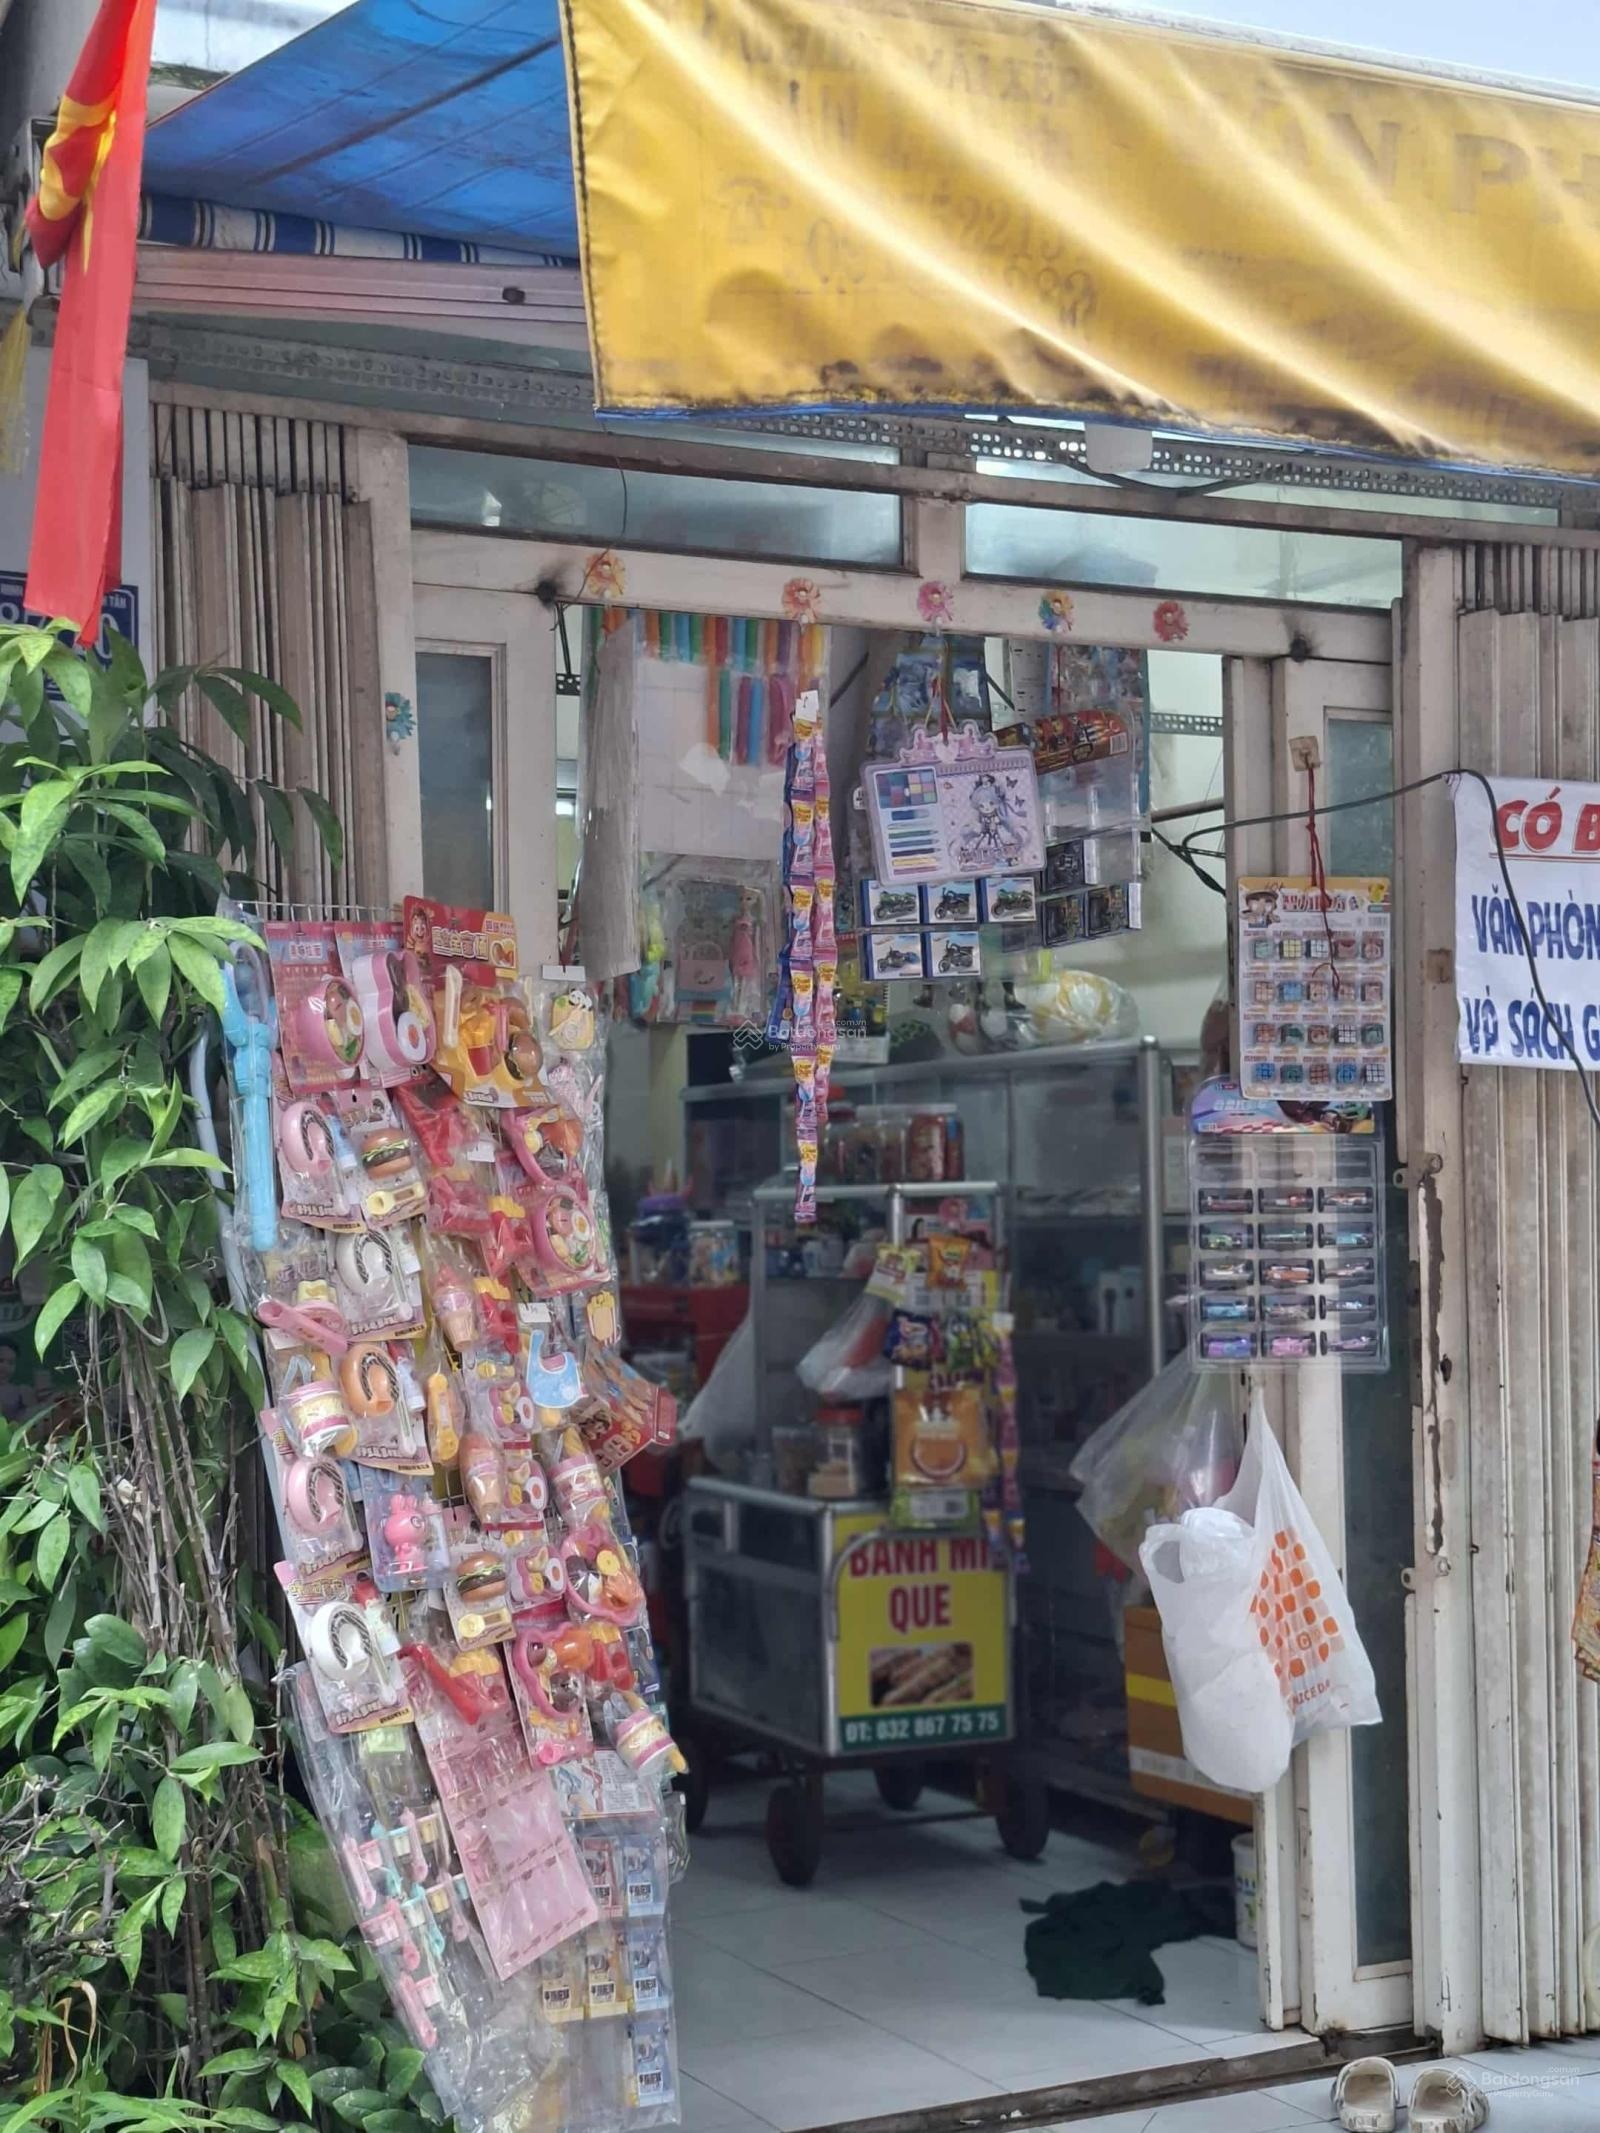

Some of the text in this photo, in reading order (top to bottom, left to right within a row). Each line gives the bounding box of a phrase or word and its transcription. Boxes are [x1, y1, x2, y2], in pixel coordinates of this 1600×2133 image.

[1491, 786, 1564, 853] CÓ
[1471, 884, 1525, 956] VĂN
[1507, 988, 1576, 1061] SÁCH
[889, 1584, 952, 1634] QUE
